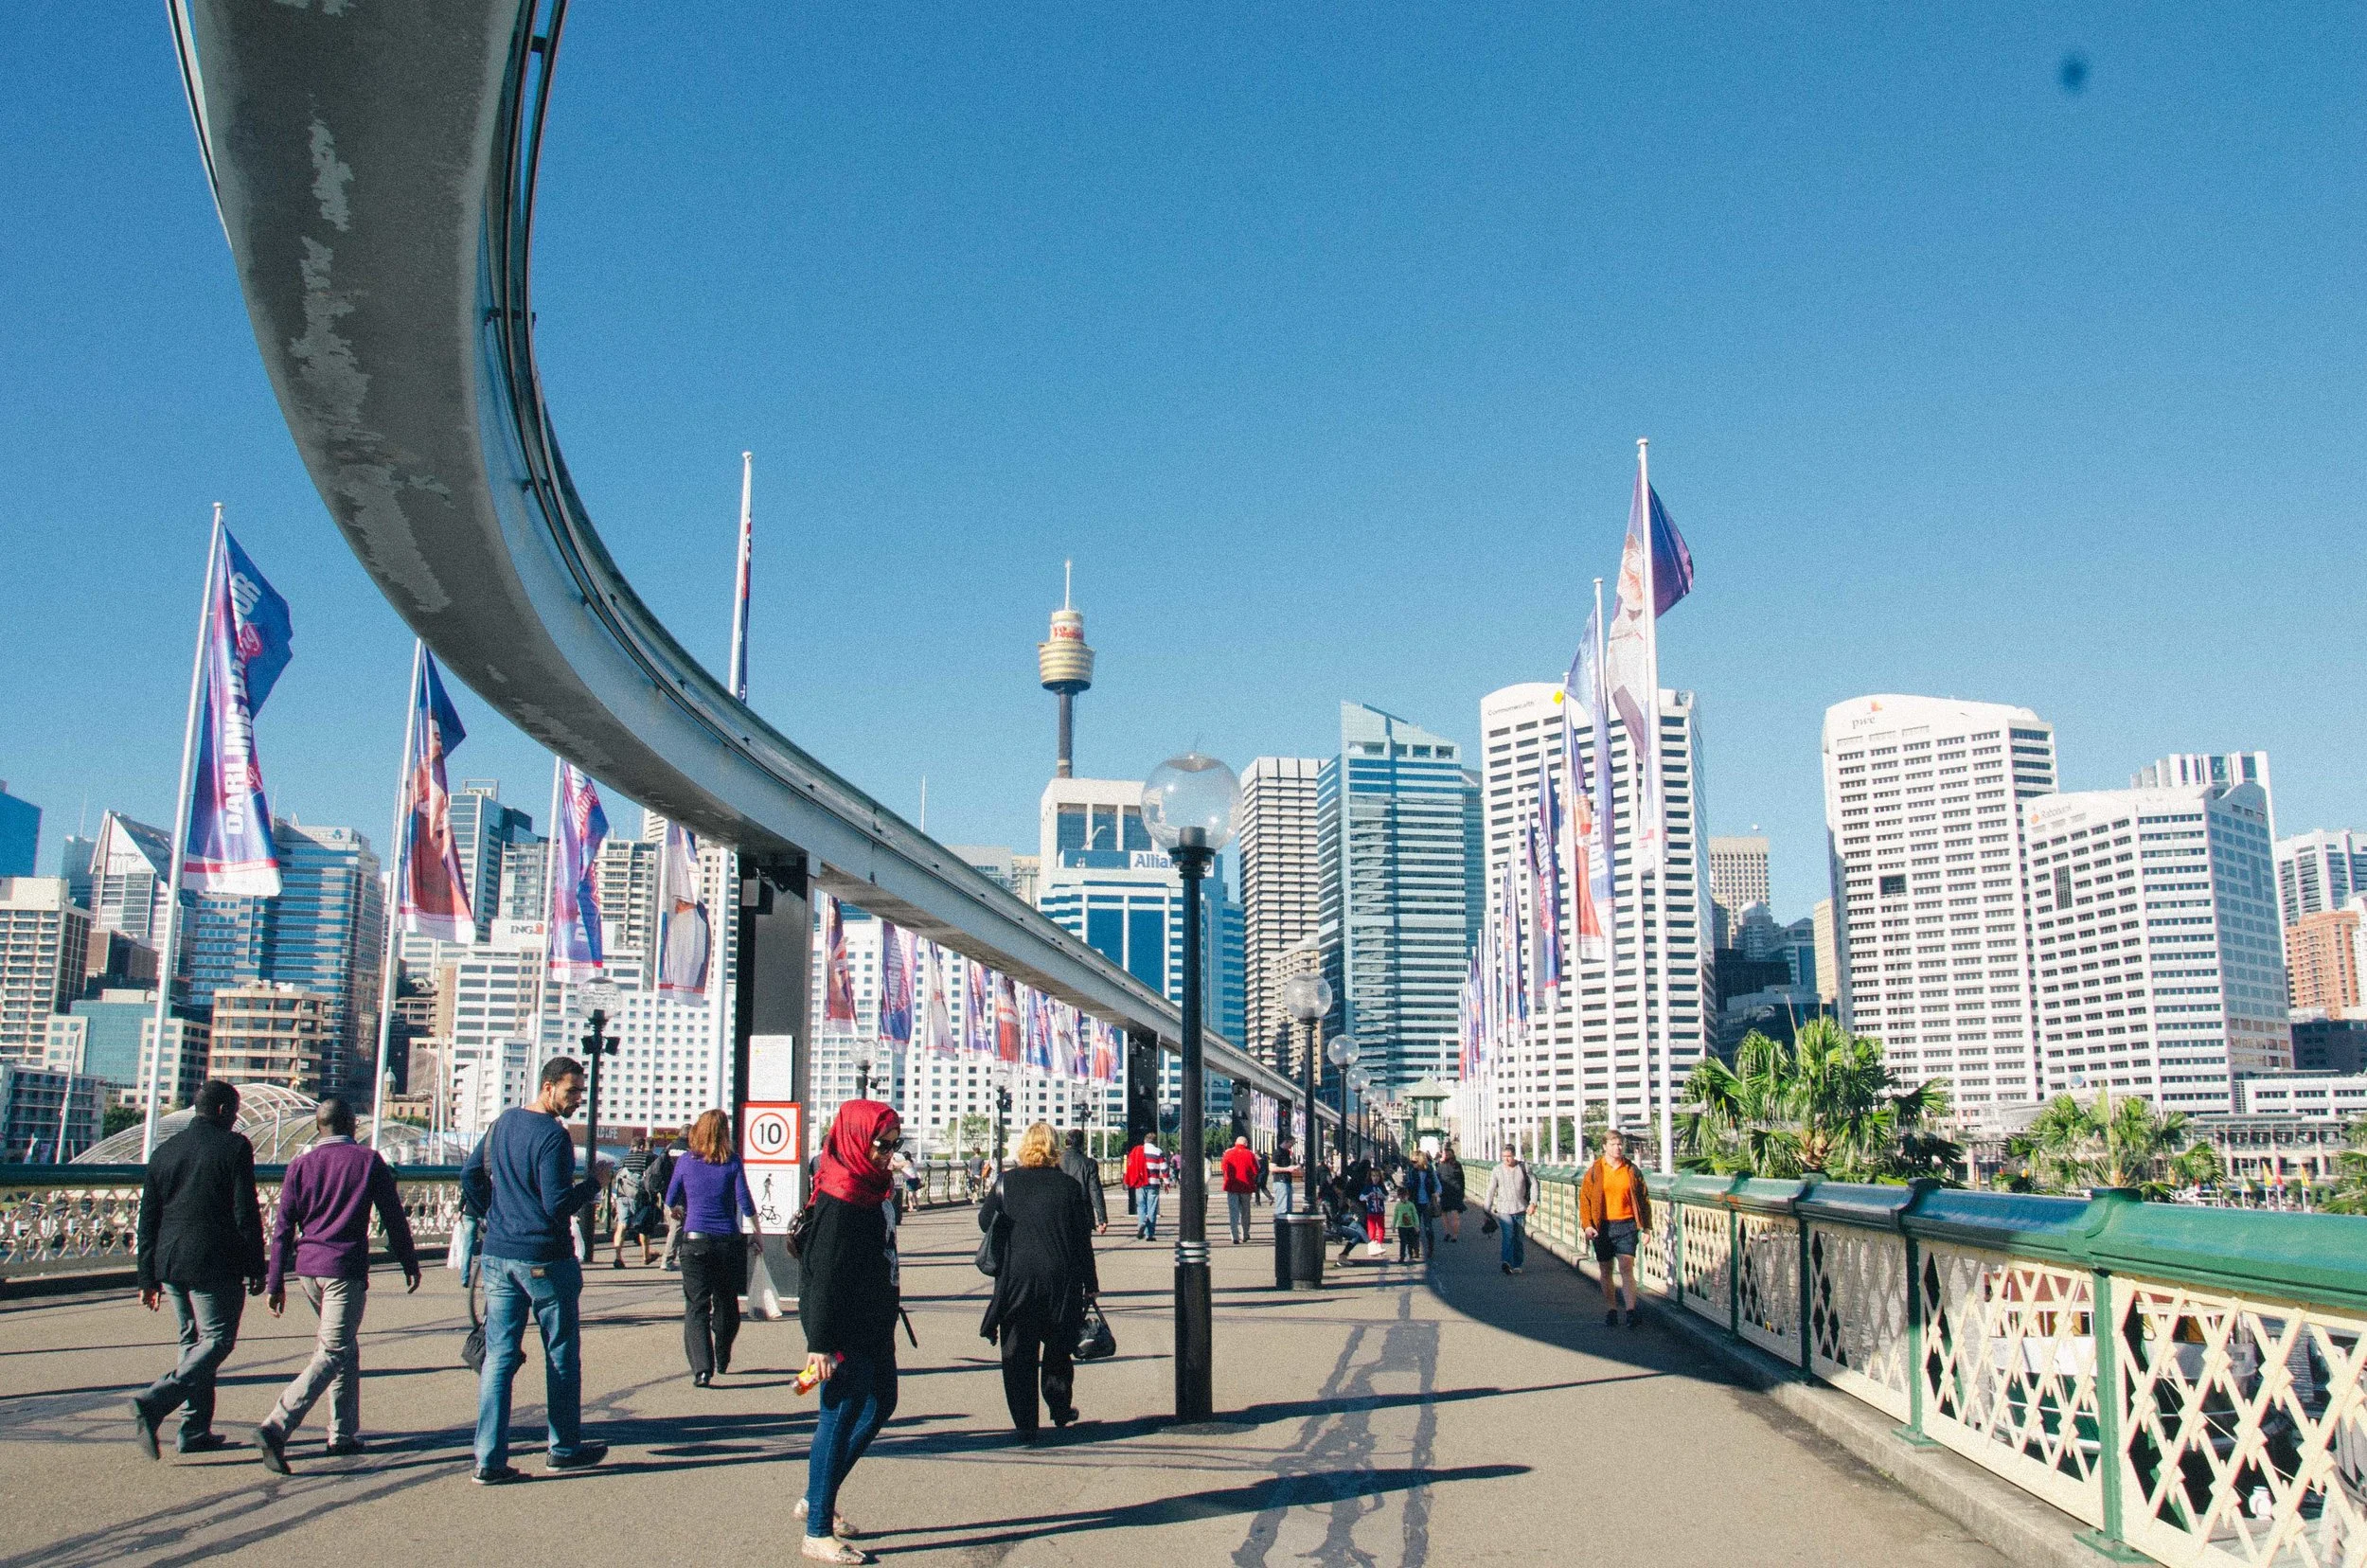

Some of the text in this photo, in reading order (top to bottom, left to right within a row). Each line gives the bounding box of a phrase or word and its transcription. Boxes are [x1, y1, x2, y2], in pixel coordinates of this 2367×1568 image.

[1852, 716, 1876, 729] pwc
[223, 703, 252, 834] DARLING
[1135, 853, 1180, 868] Allia
[511, 925, 533, 935] ING
[760, 1123, 781, 1145] 10
